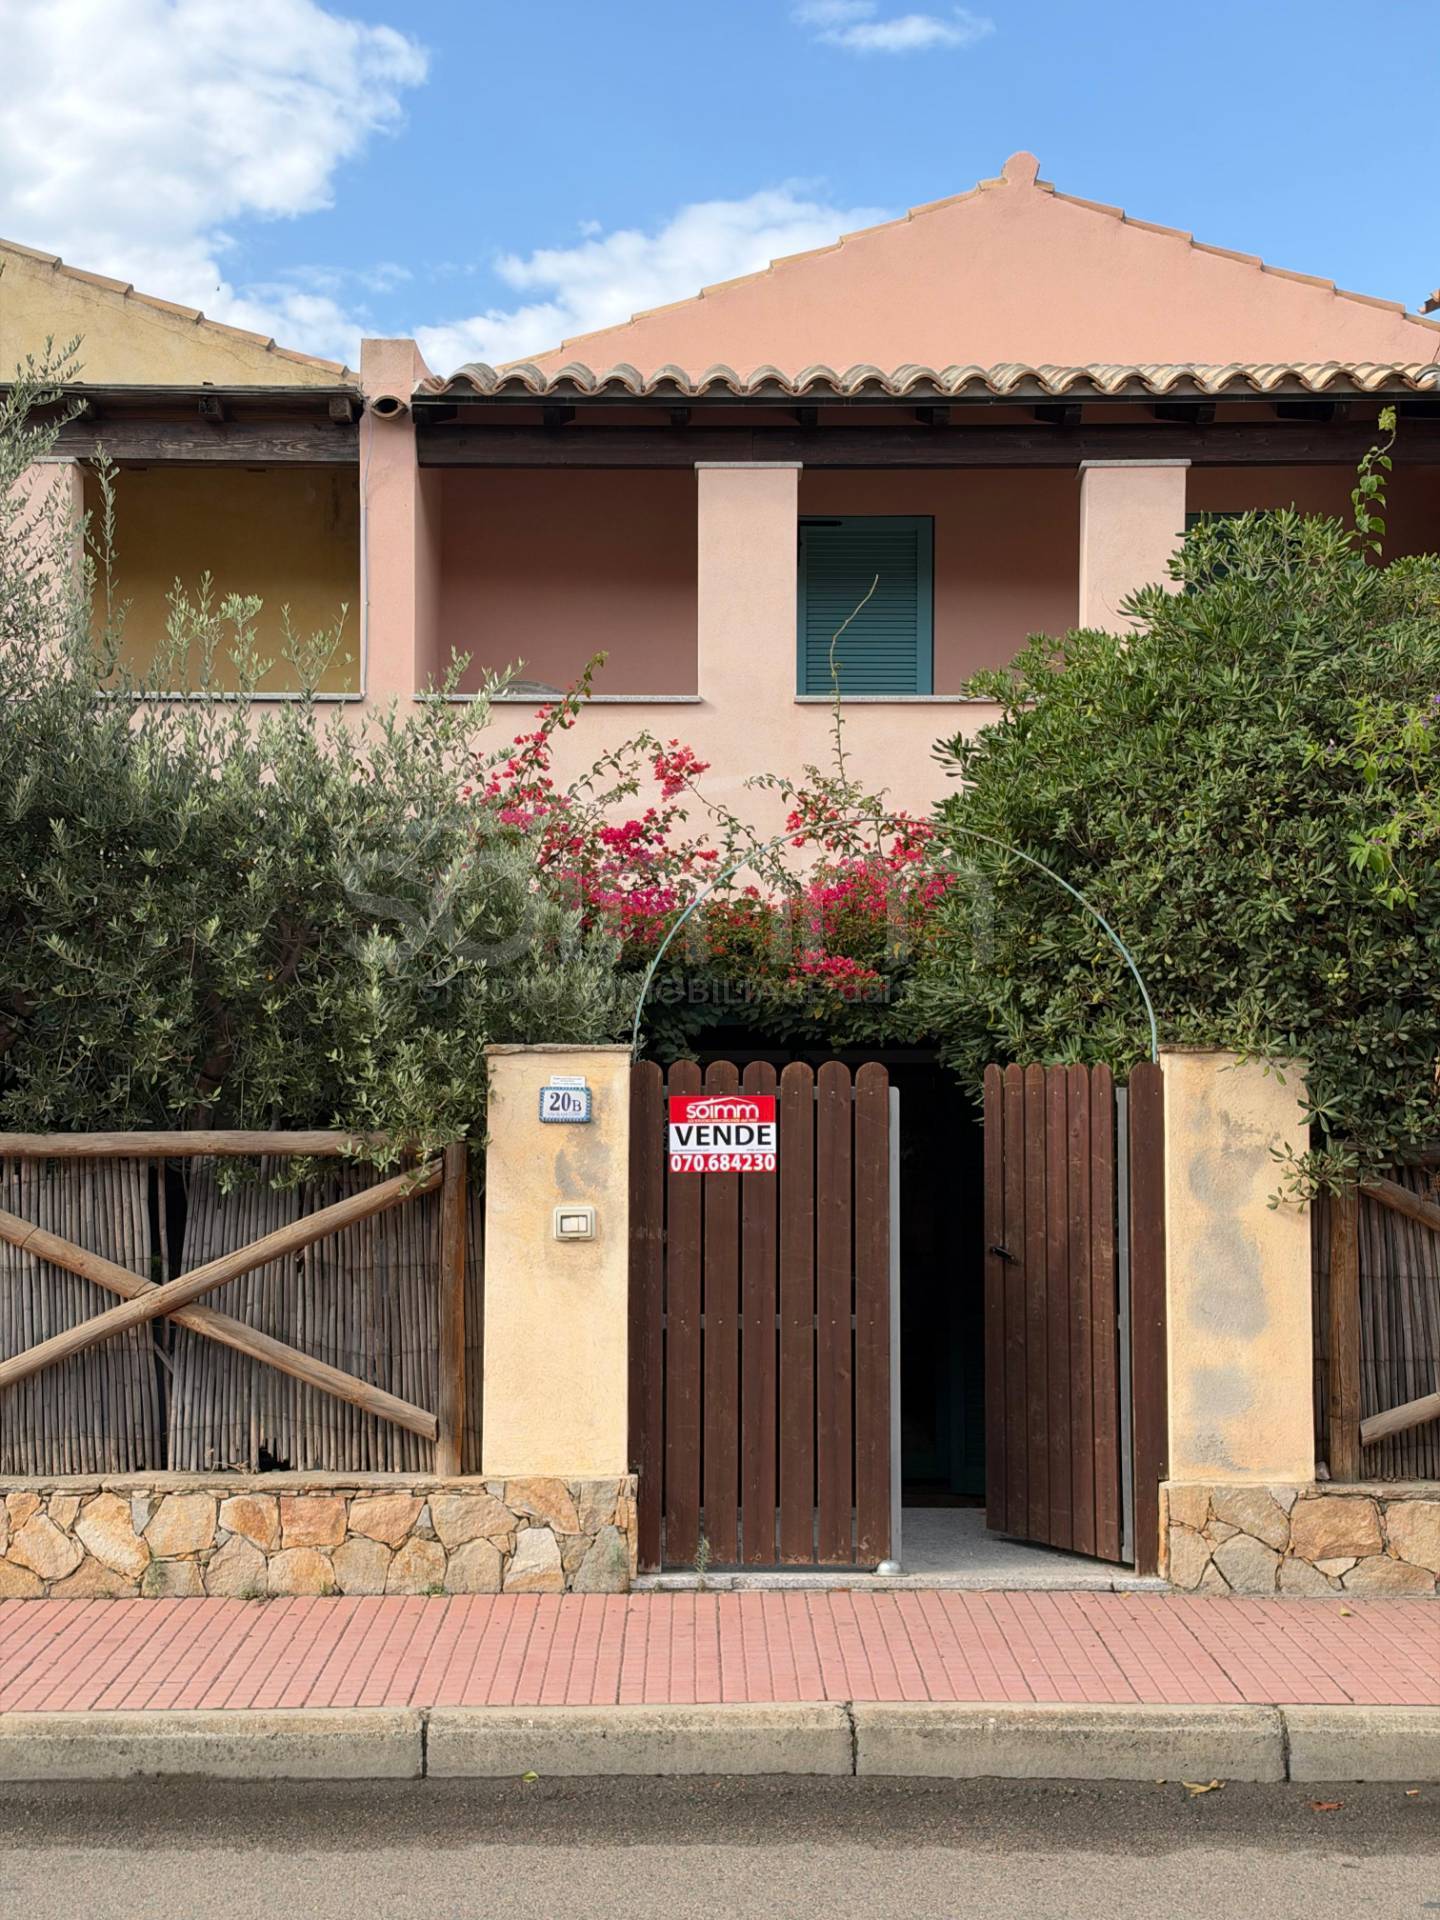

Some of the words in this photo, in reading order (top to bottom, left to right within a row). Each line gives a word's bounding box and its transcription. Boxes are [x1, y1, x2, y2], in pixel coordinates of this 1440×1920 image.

[686, 1104, 759, 1119] soimm
[675, 1125, 771, 1146] VENDE
[671, 1154, 775, 1172] 070.684230
